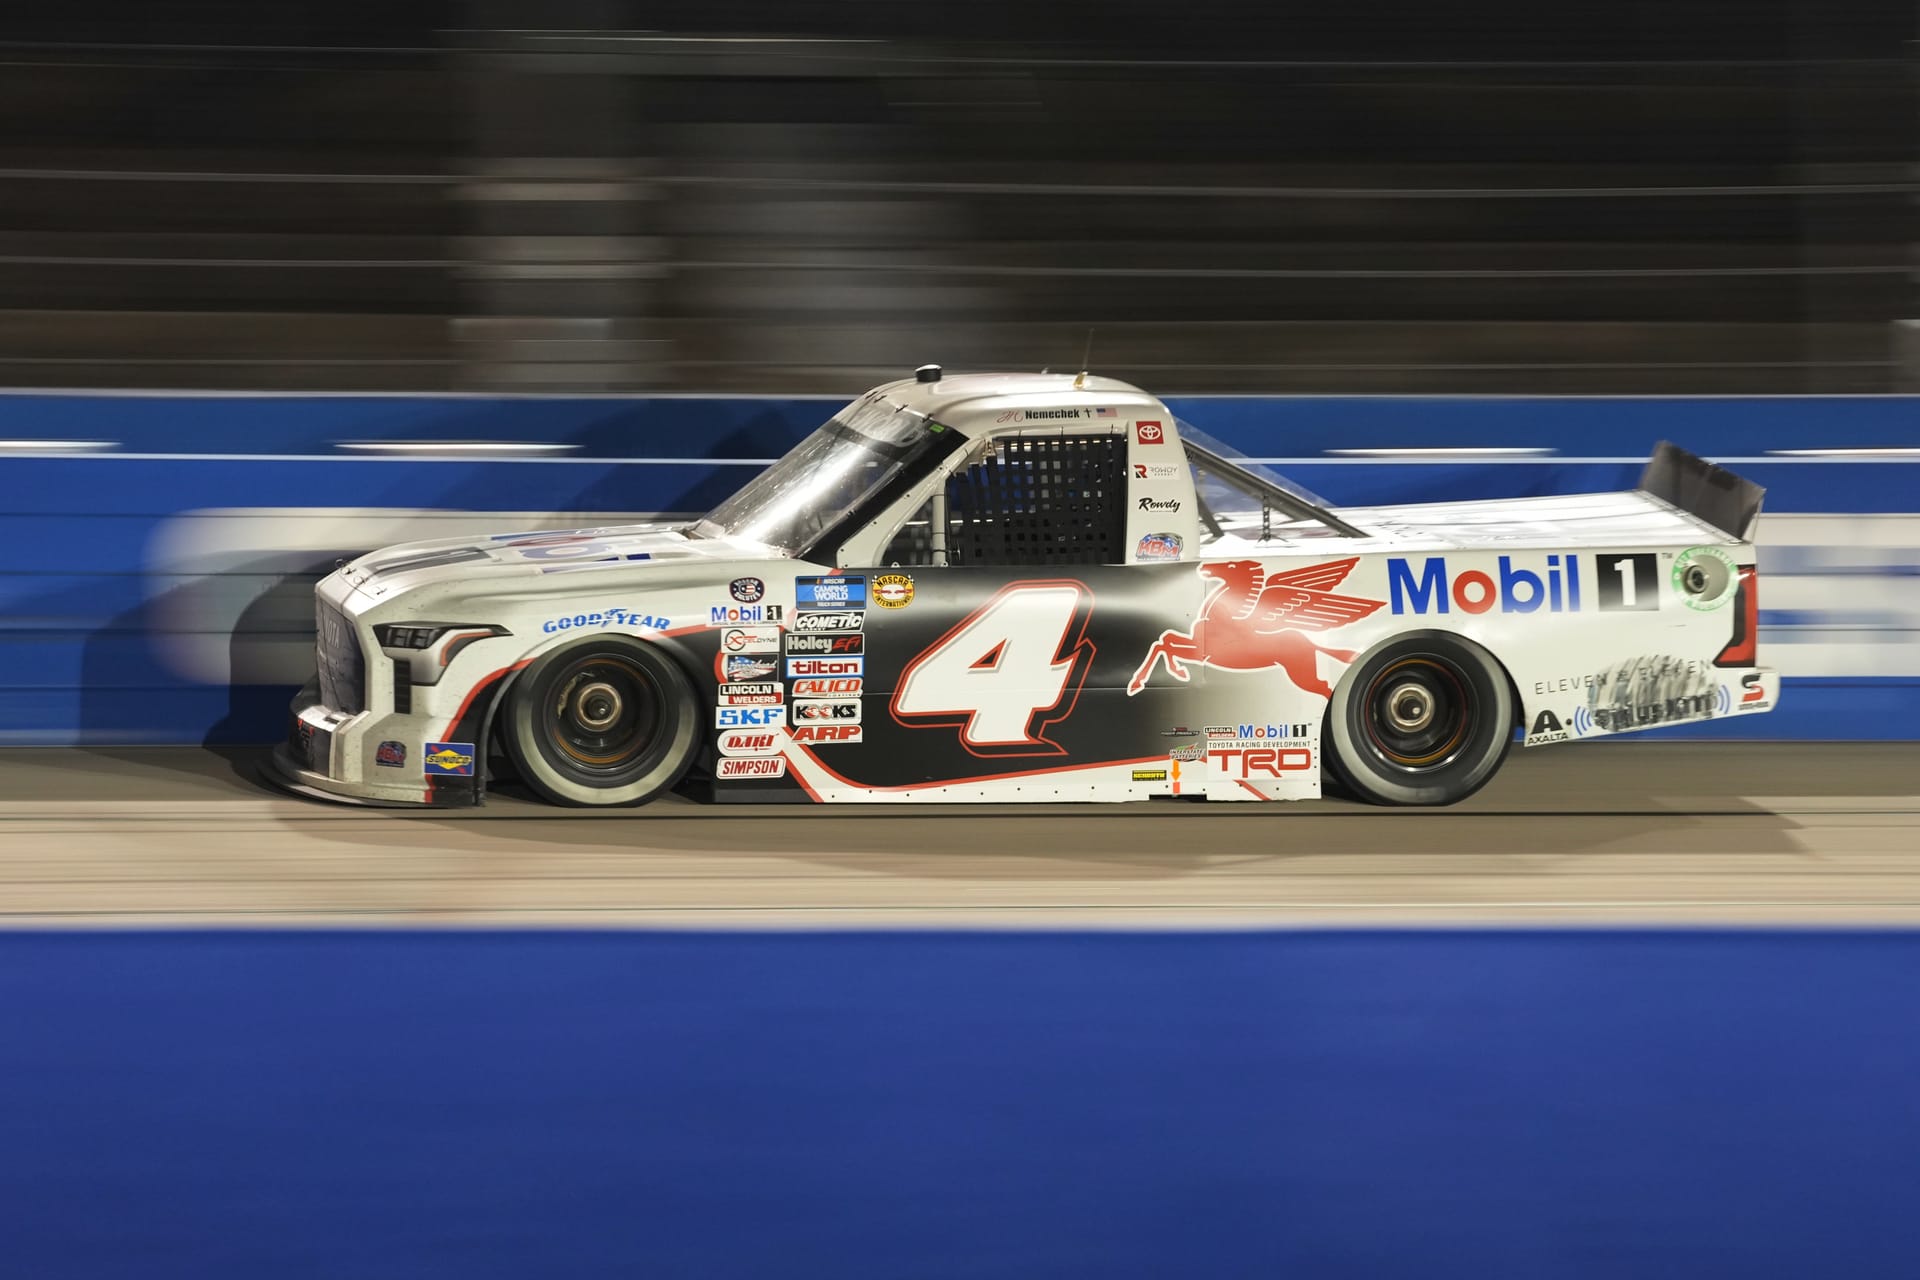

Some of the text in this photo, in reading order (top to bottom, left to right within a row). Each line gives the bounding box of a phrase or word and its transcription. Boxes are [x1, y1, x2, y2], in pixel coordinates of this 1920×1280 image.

[1025, 409, 1080, 419] Nemechek
[1139, 497, 1181, 513] Rowdy
[1137, 540, 1180, 557] KBM
[814, 585, 849, 593] CAMPING
[876, 576, 909, 587] NASCAR
[1387, 554, 1581, 615] Mobil
[815, 592, 849, 601] WORLD
[711, 605, 761, 621] Mobil
[796, 612, 863, 628] COMETIC
[788, 636, 833, 654] Holley
[792, 660, 858, 674] tilton
[891, 581, 1085, 748] 4
[722, 685, 772, 695] LINCOLN
[794, 679, 861, 694] CALICO
[1535, 674, 1607, 695] ELEVEN
[733, 695, 777, 704] WELDERS
[719, 708, 783, 725] SKF
[795, 704, 857, 720] KOOKS
[792, 726, 861, 741] ARP
[1239, 724, 1288, 738] Mobil
[1263, 740, 1311, 748] DEVELOPMENT
[1527, 732, 1569, 746] AXALTA
[429, 756, 471, 764] SUNOCO
[722, 759, 779, 775] SIMPSON
[1208, 748, 1311, 778] TRD
